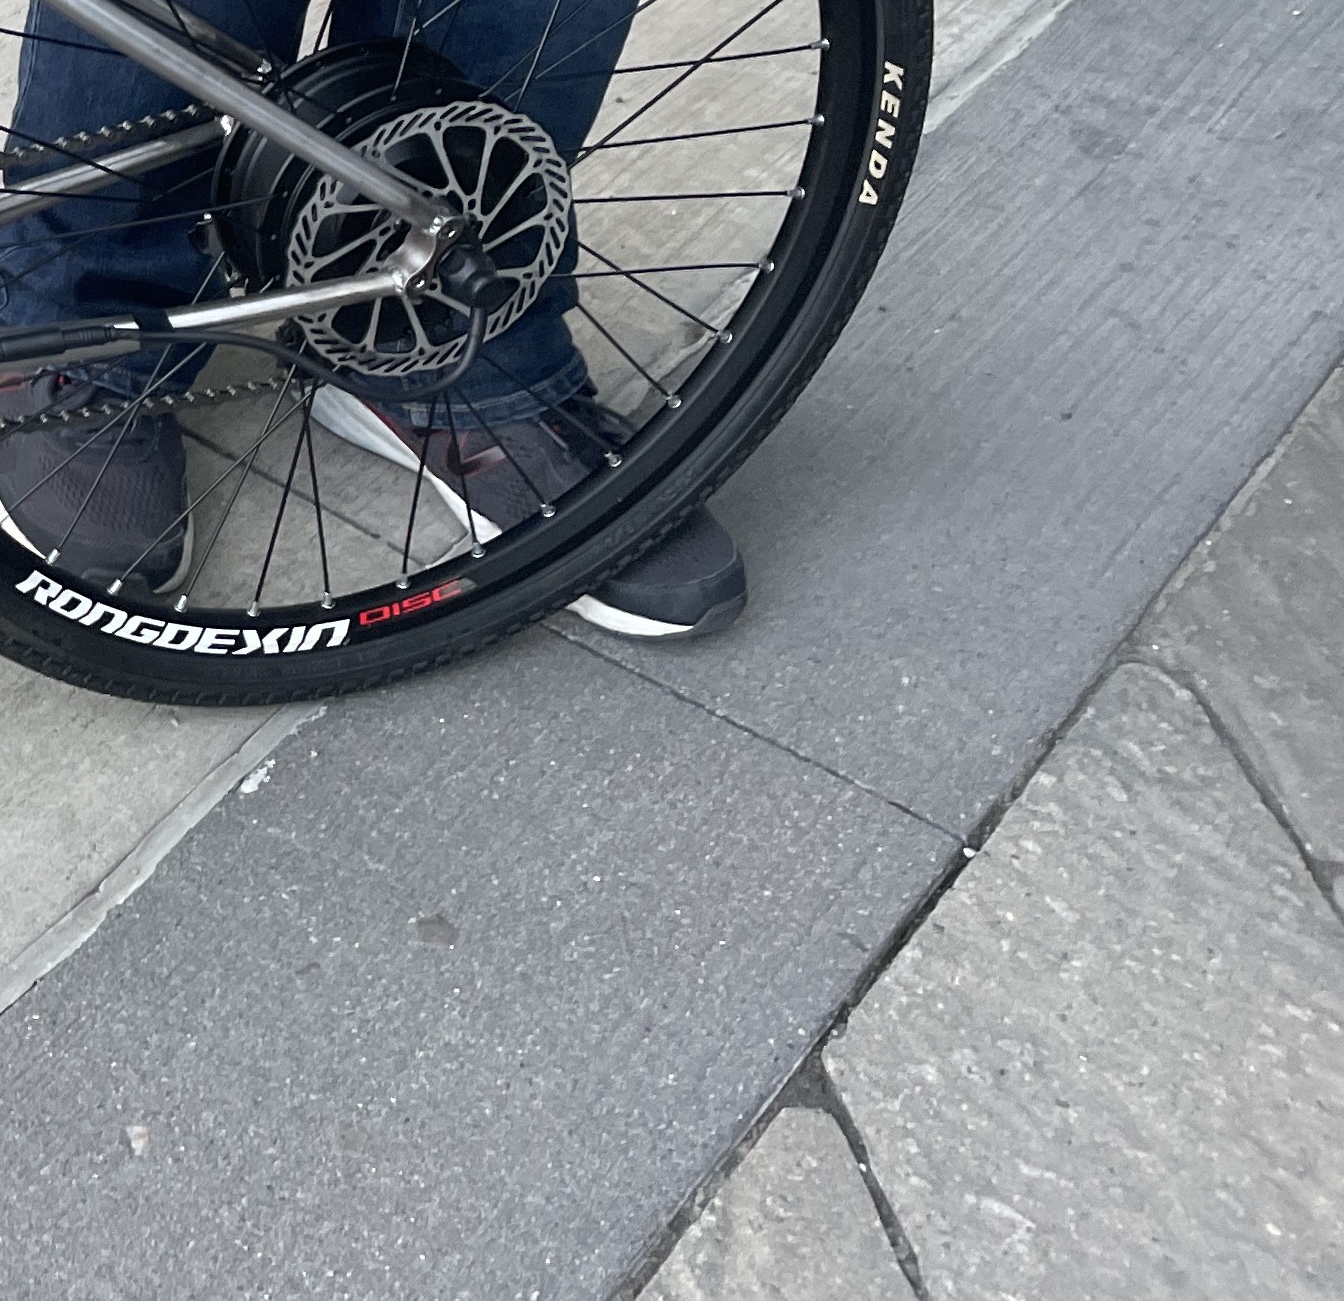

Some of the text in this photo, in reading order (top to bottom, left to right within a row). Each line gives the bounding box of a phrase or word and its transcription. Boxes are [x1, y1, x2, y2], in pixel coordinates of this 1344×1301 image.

[859, 61, 905, 205] KENDA
[15, 570, 462, 656] RONGDEXIN DISC
